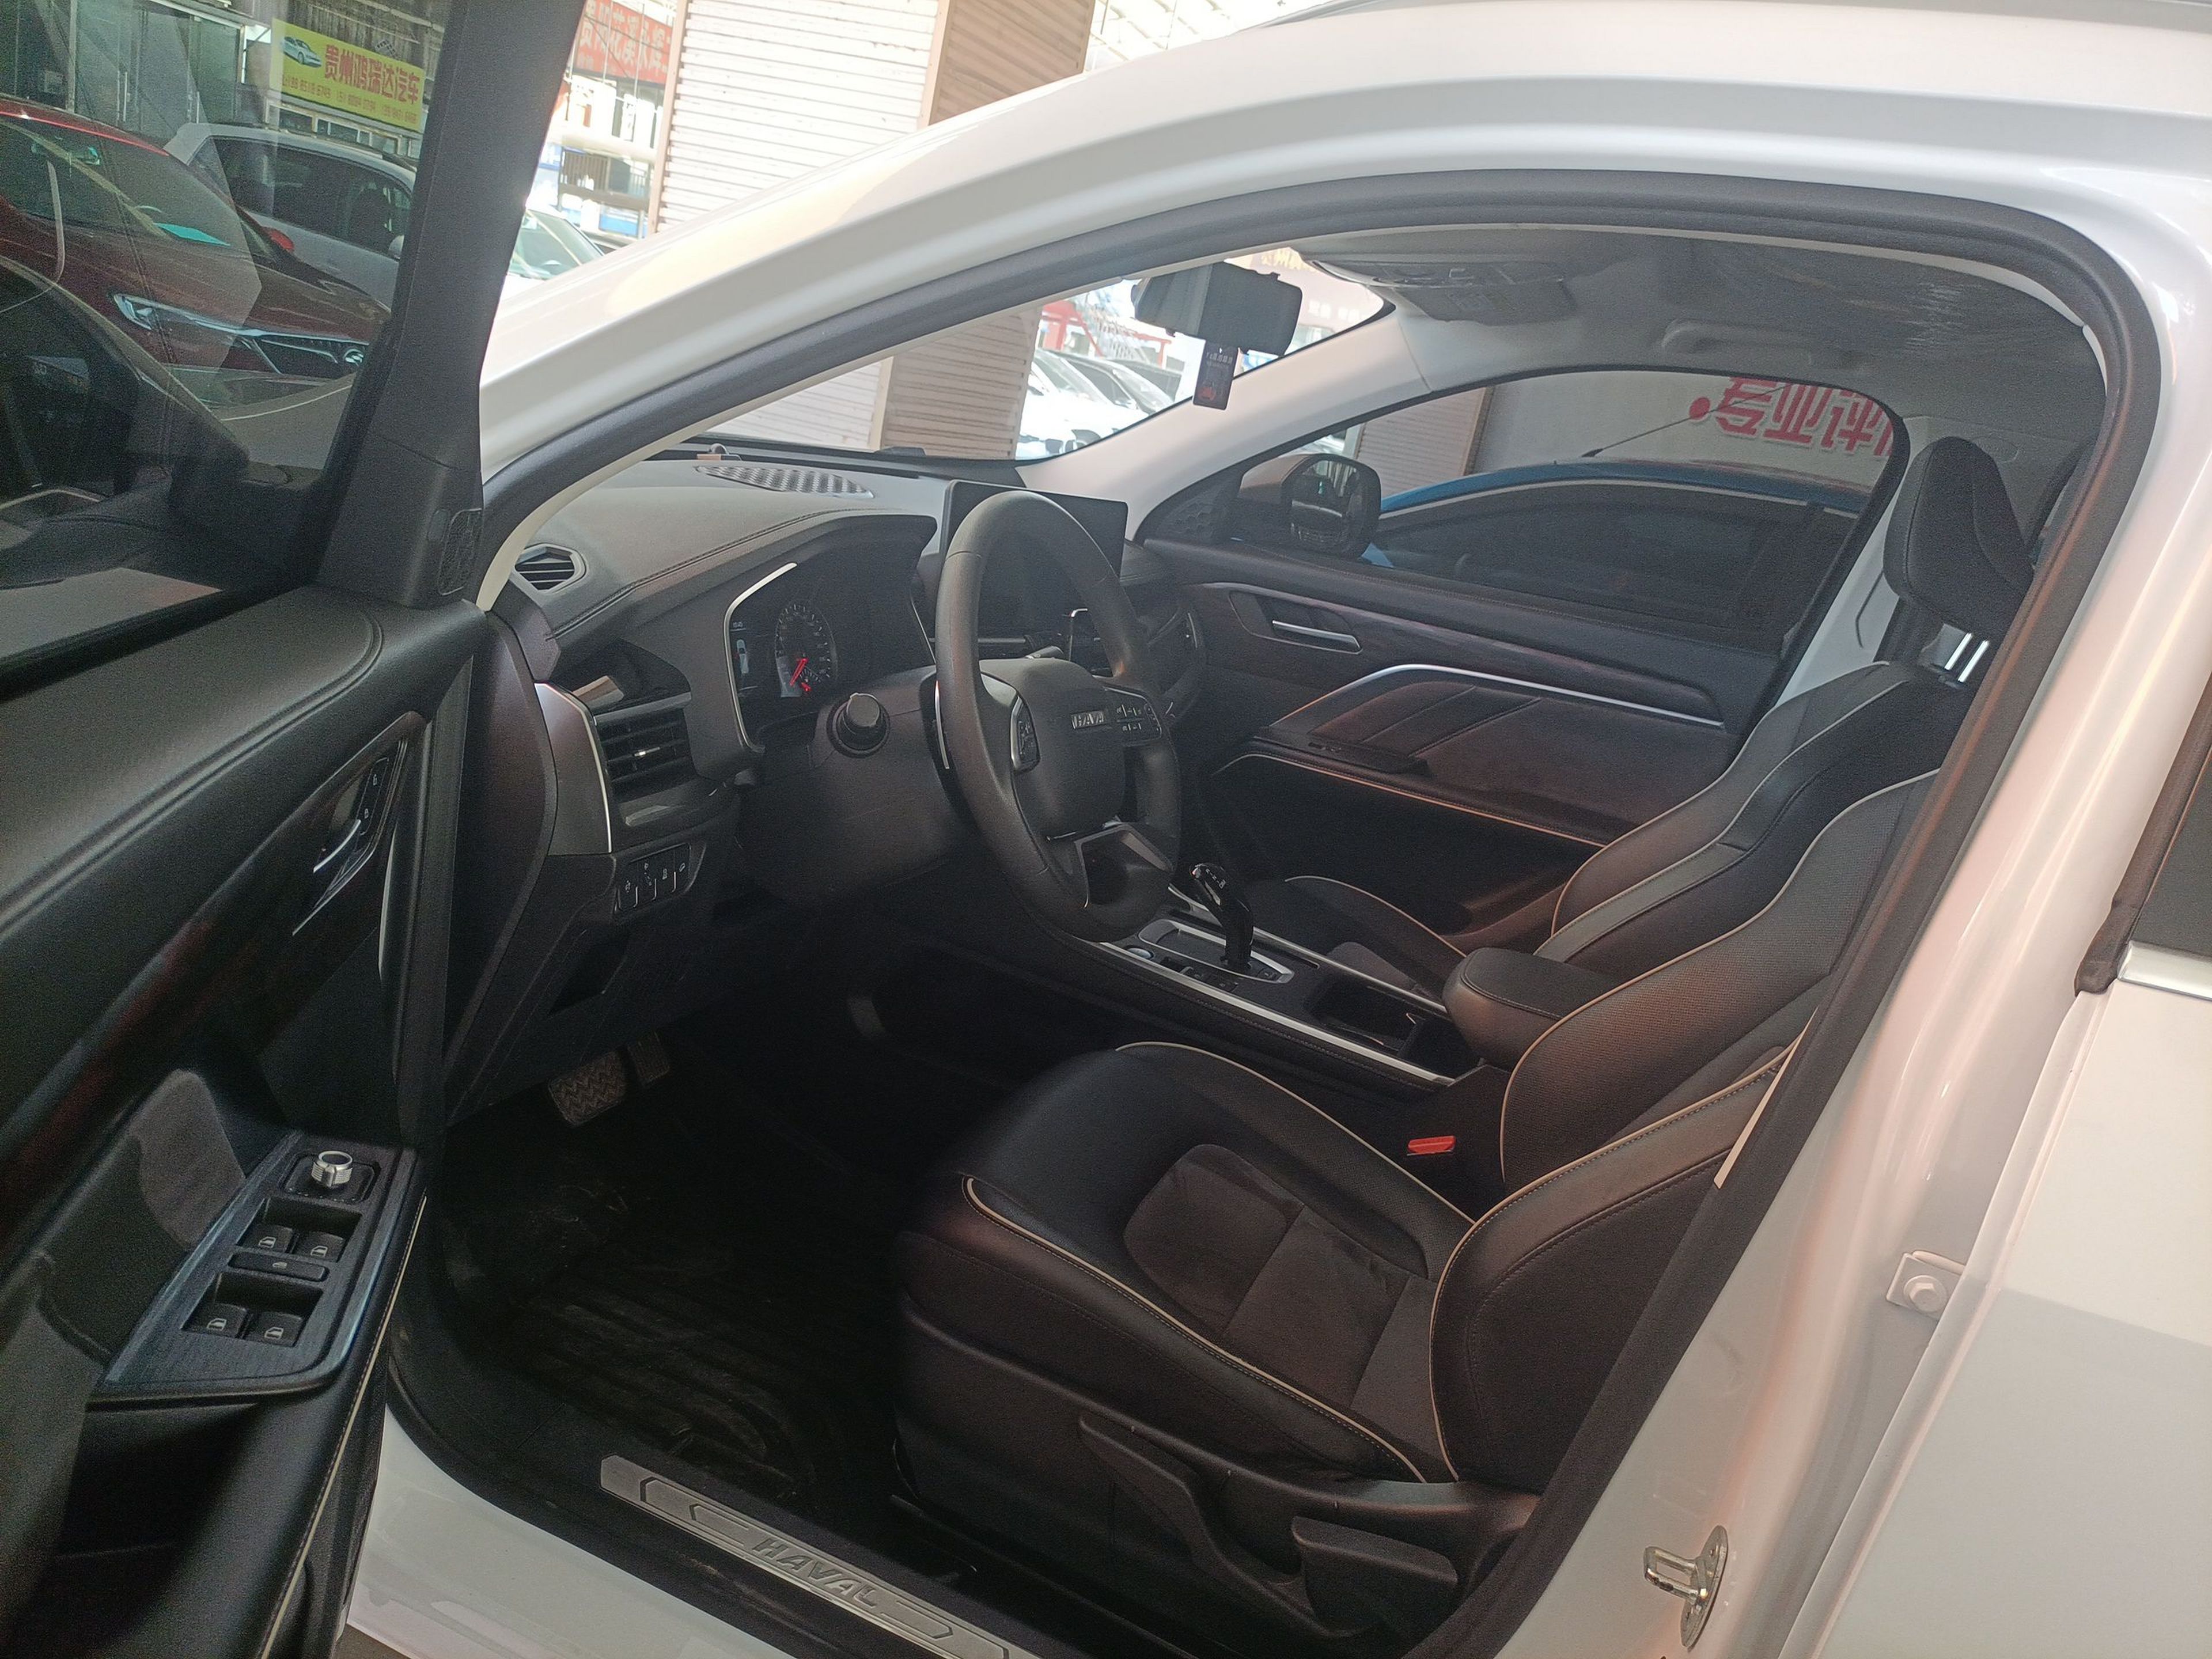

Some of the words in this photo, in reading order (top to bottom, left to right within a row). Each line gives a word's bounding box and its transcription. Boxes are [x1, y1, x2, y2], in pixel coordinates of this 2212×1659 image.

[325, 44, 421, 104] 贵州鸿瑞达汽车
[752, 1537, 876, 1608] HAVAL
